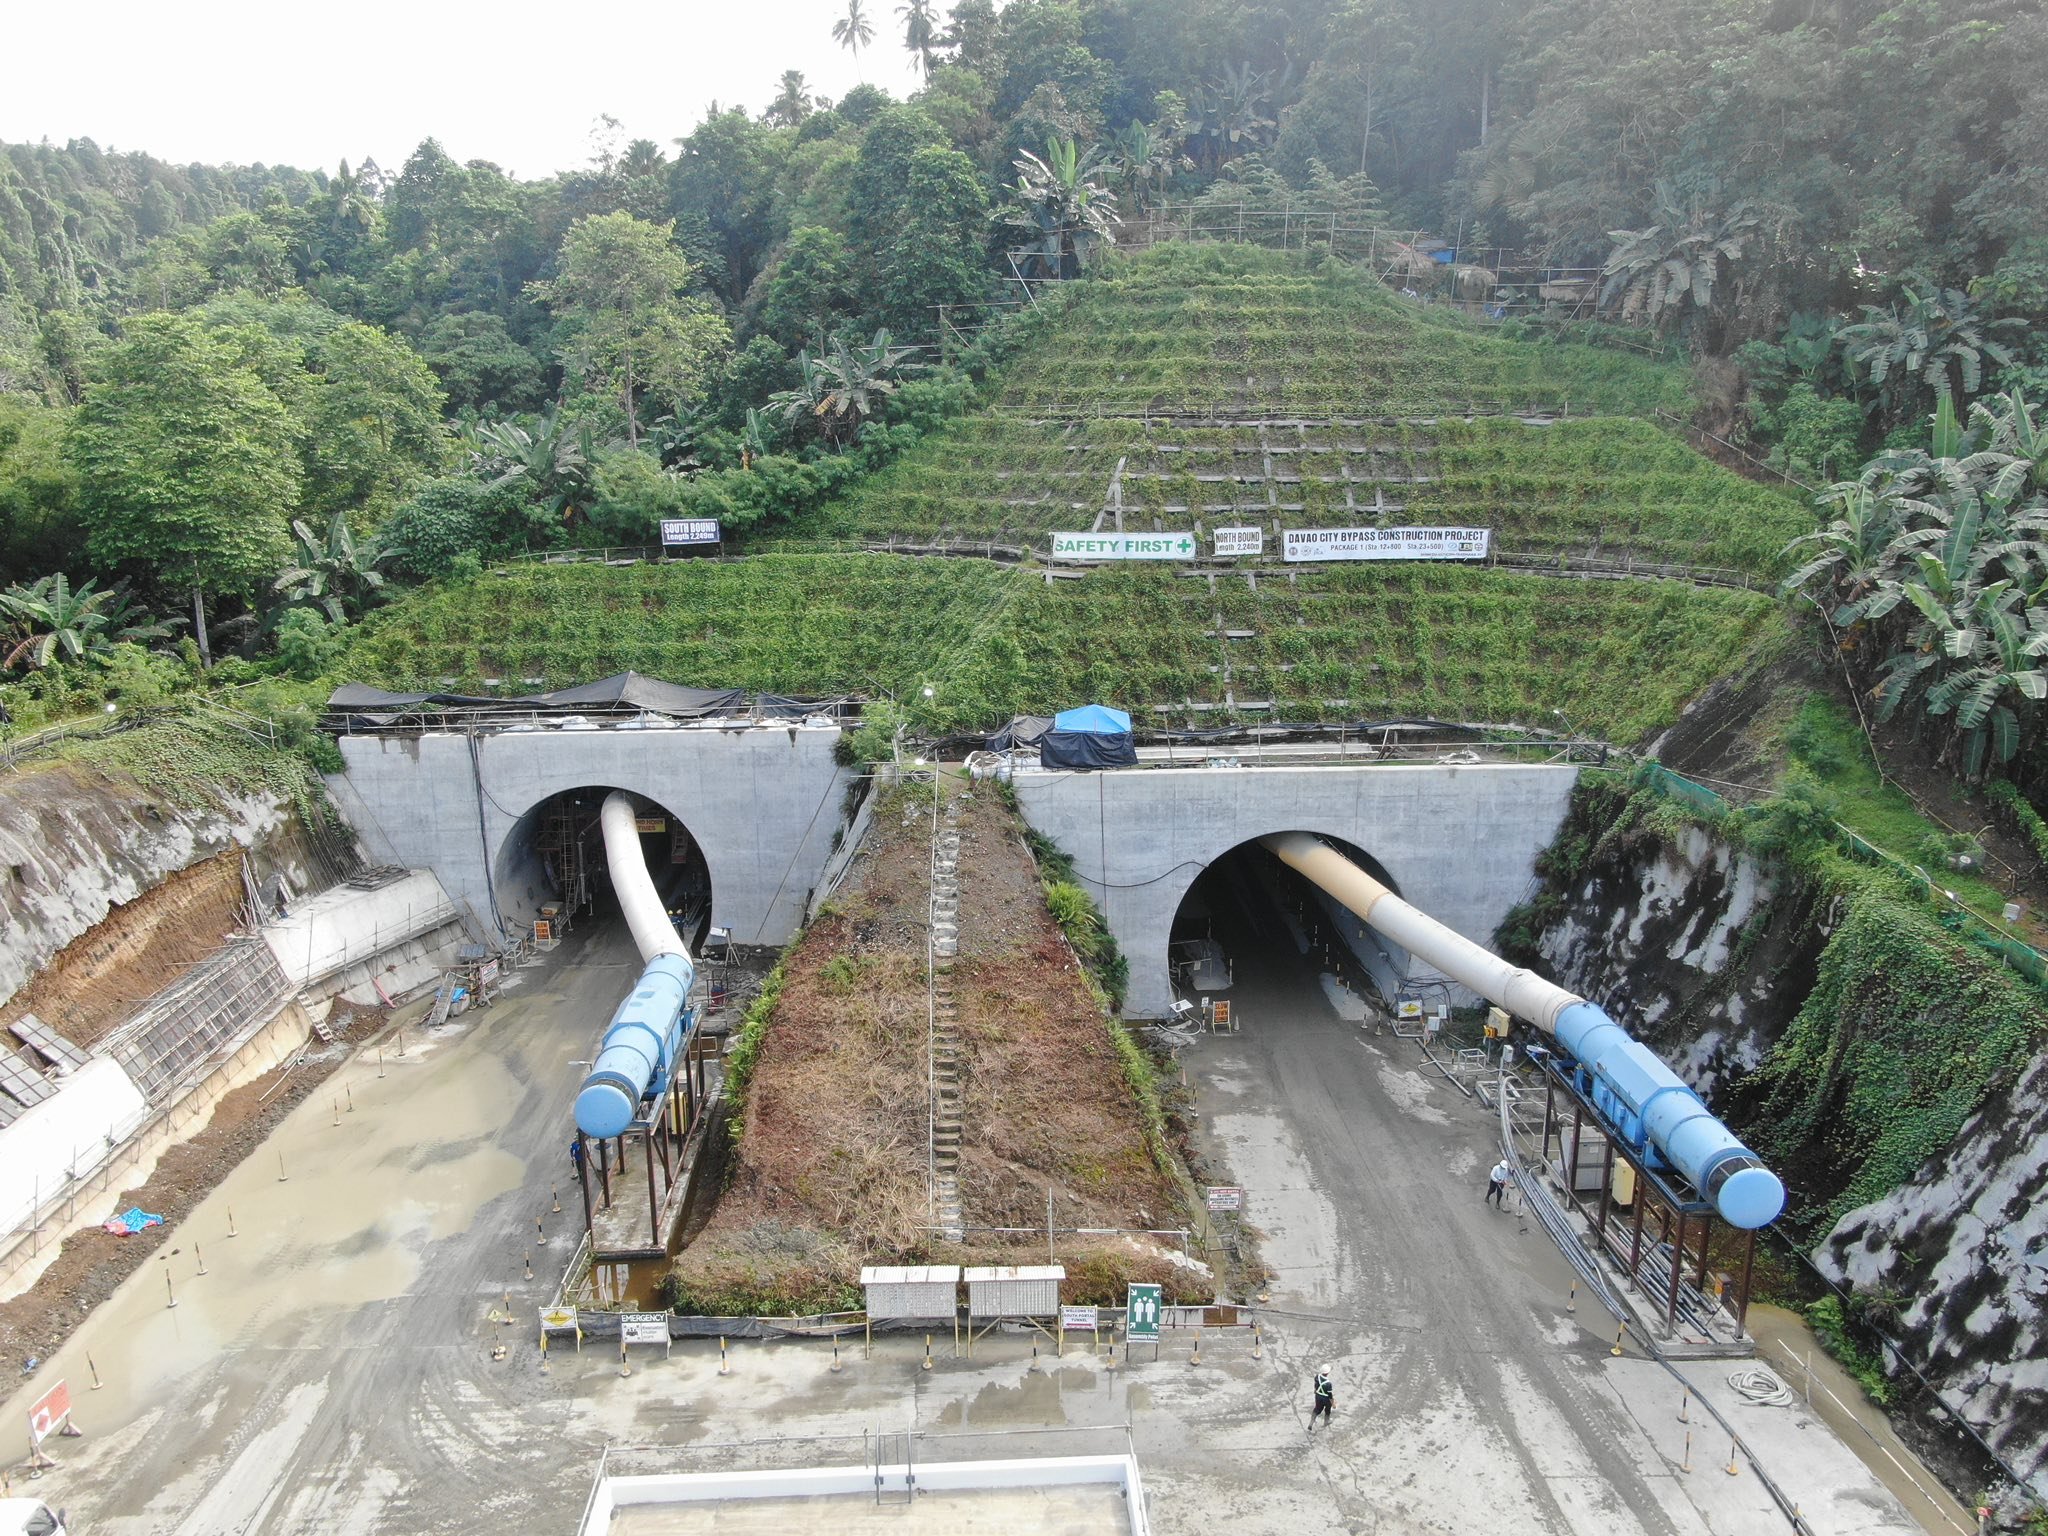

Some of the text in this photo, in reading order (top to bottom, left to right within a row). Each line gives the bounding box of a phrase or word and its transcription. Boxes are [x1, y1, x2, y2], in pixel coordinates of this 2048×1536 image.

[664, 522, 716, 533] SOUTH BOUND
[667, 533, 689, 541] Length
[1216, 532, 1260, 543] NORTH BOUND
[1288, 530, 1484, 543] DAVAO CITY BYPASS CONSTRUCTION PROJECT
[1055, 540, 1173, 552] SAFETY FIRST
[621, 1313, 665, 1322] EMERGENCY
